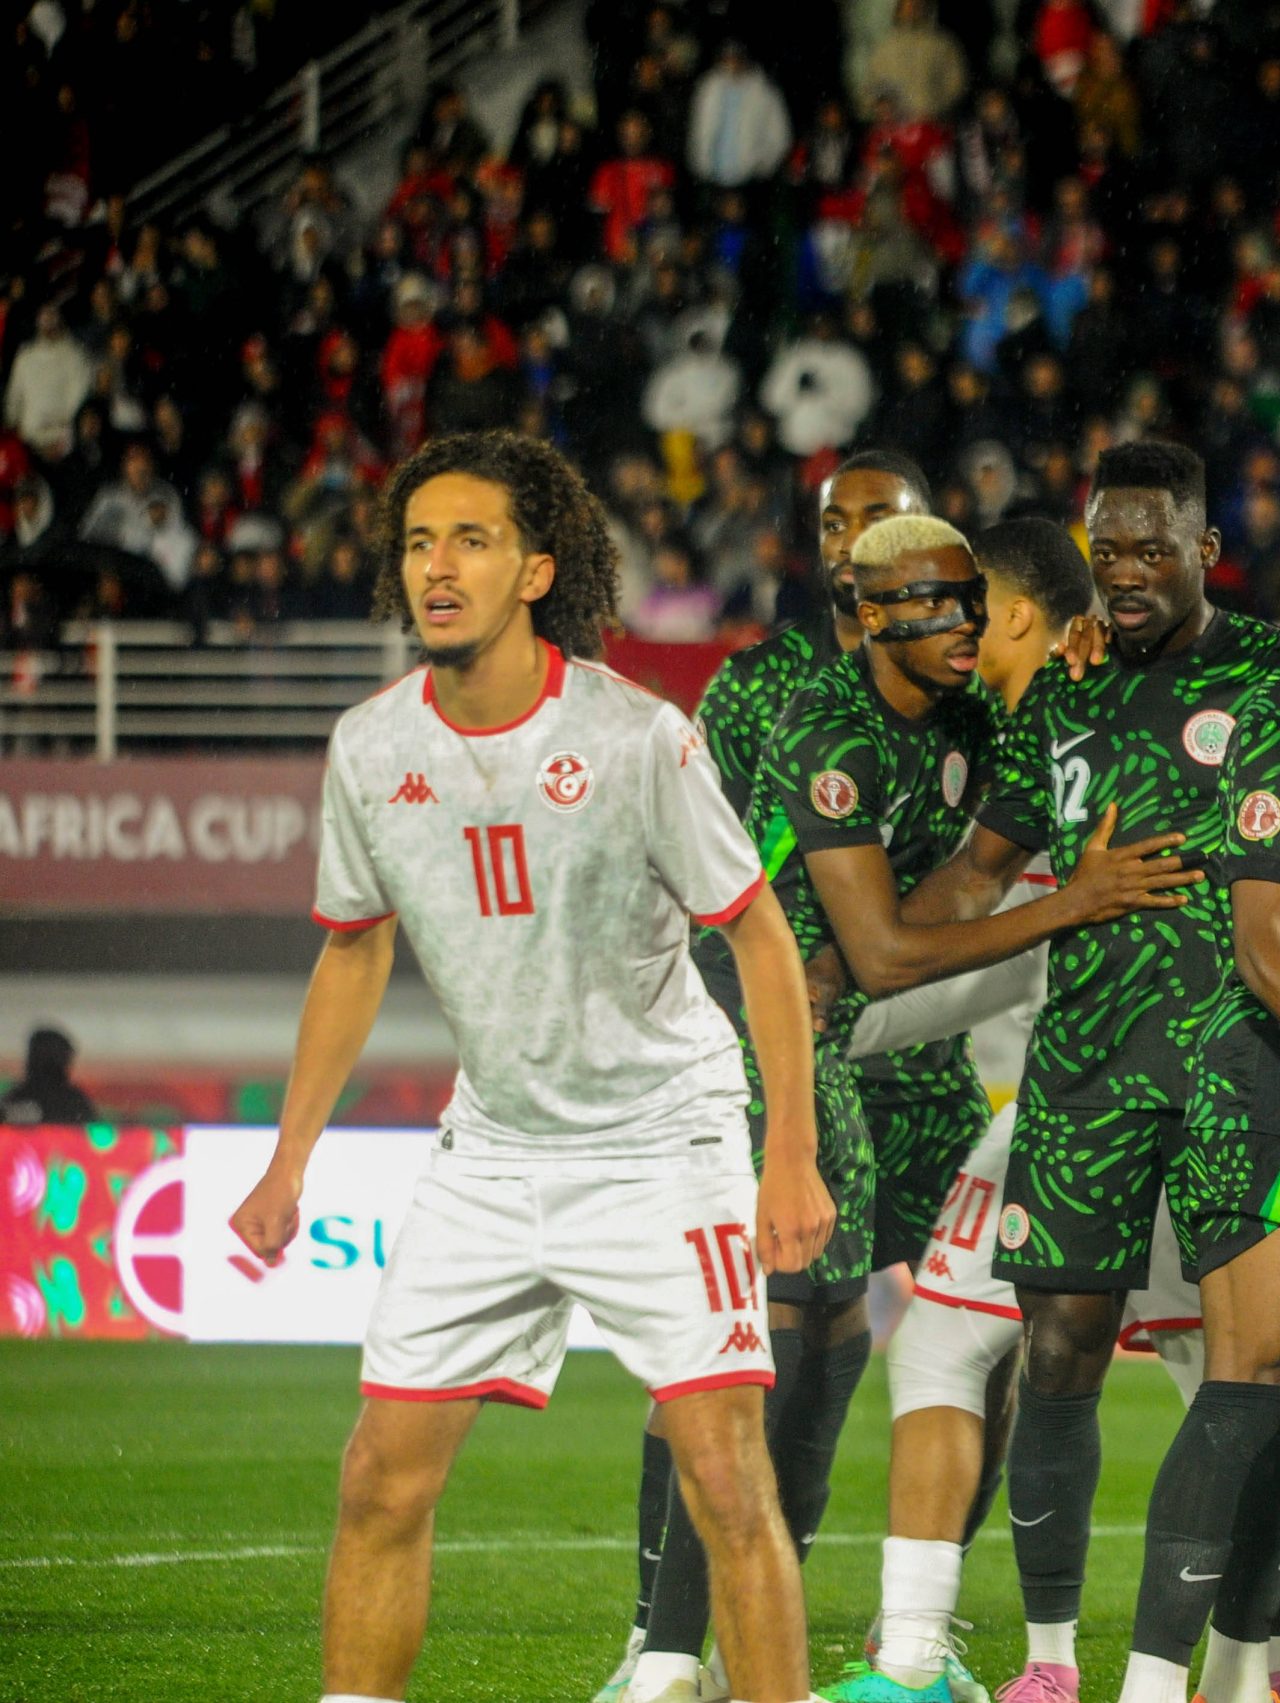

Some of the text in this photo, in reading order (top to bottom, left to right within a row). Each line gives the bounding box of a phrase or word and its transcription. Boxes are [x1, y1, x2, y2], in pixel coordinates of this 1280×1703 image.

[0, 794, 306, 863] AFRICA CUP
[463, 823, 535, 918] 10
[684, 1222, 758, 1313] 10
